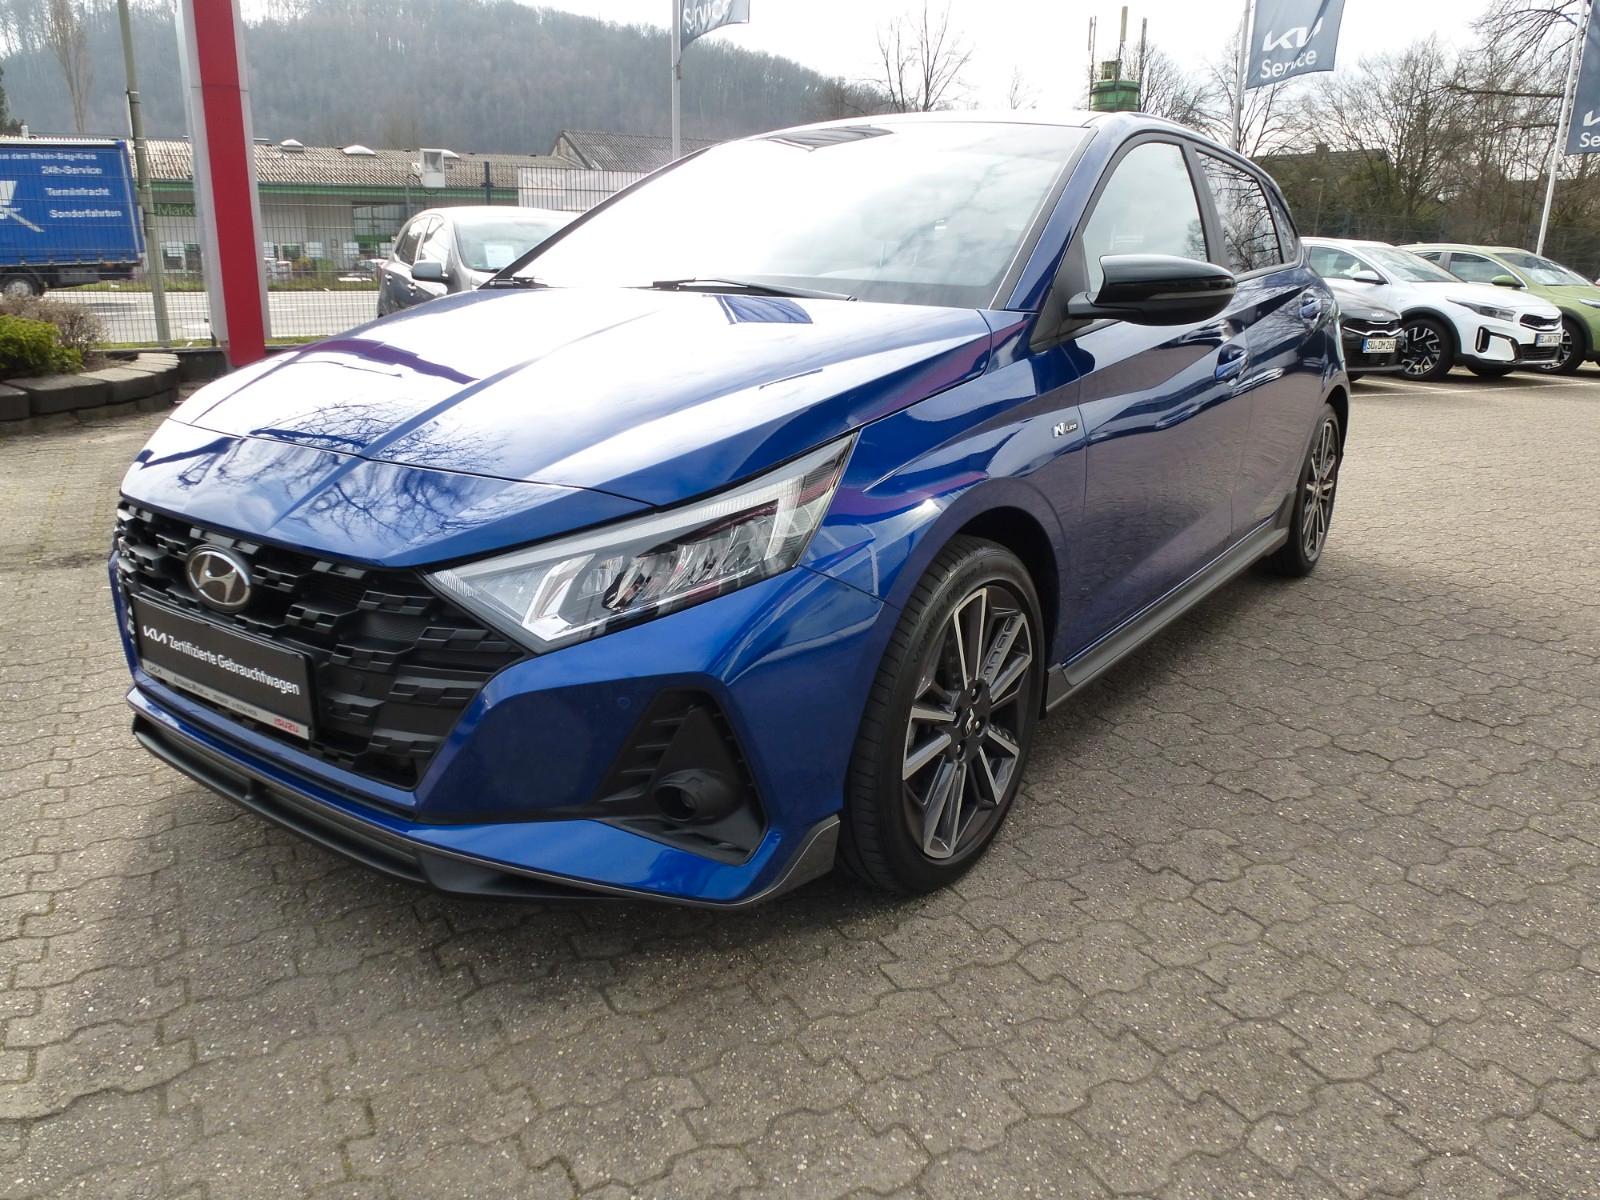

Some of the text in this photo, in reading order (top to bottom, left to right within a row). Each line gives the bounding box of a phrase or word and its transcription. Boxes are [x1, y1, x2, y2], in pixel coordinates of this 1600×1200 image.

[1260, 50, 1317, 78] Servce
[41, 165, 102, 175] 24h-Service
[49, 209, 122, 218] Sonderfahrten
[142, 625, 168, 645] KIA
[168, 635, 217, 666] Zertifizierte
[217, 653, 300, 697] Gebrauchtwagen
